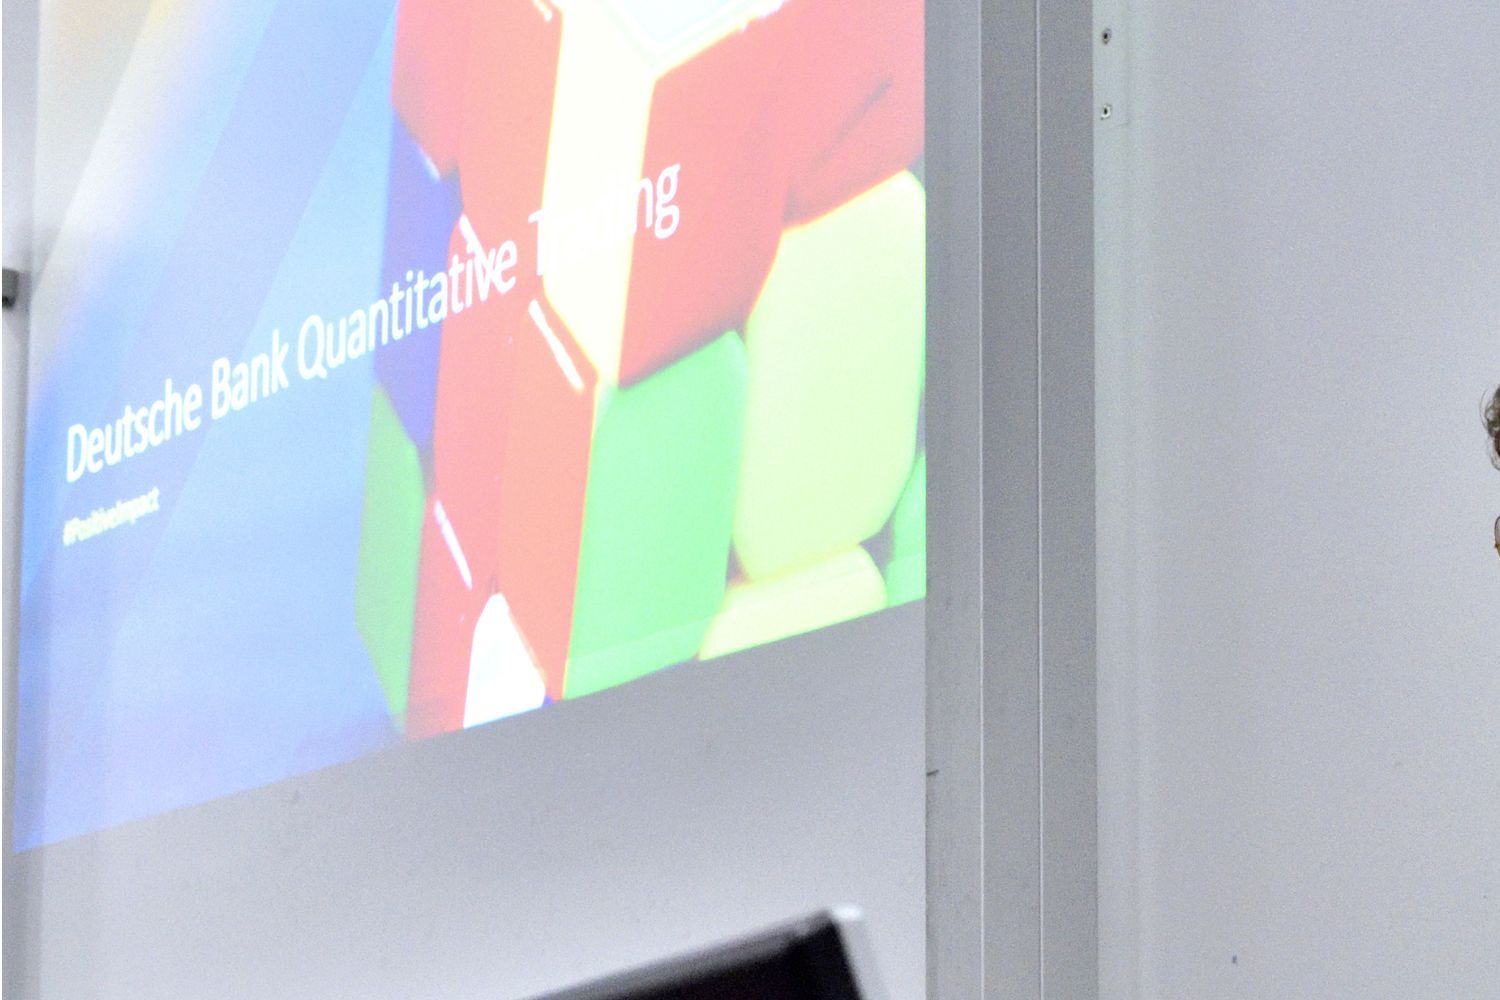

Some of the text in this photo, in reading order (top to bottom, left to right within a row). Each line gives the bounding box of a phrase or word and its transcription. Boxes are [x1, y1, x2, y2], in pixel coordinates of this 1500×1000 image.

[67, 378, 202, 482] Deutsche
[211, 330, 289, 419] Bank
[298, 240, 517, 378] Quantitative
